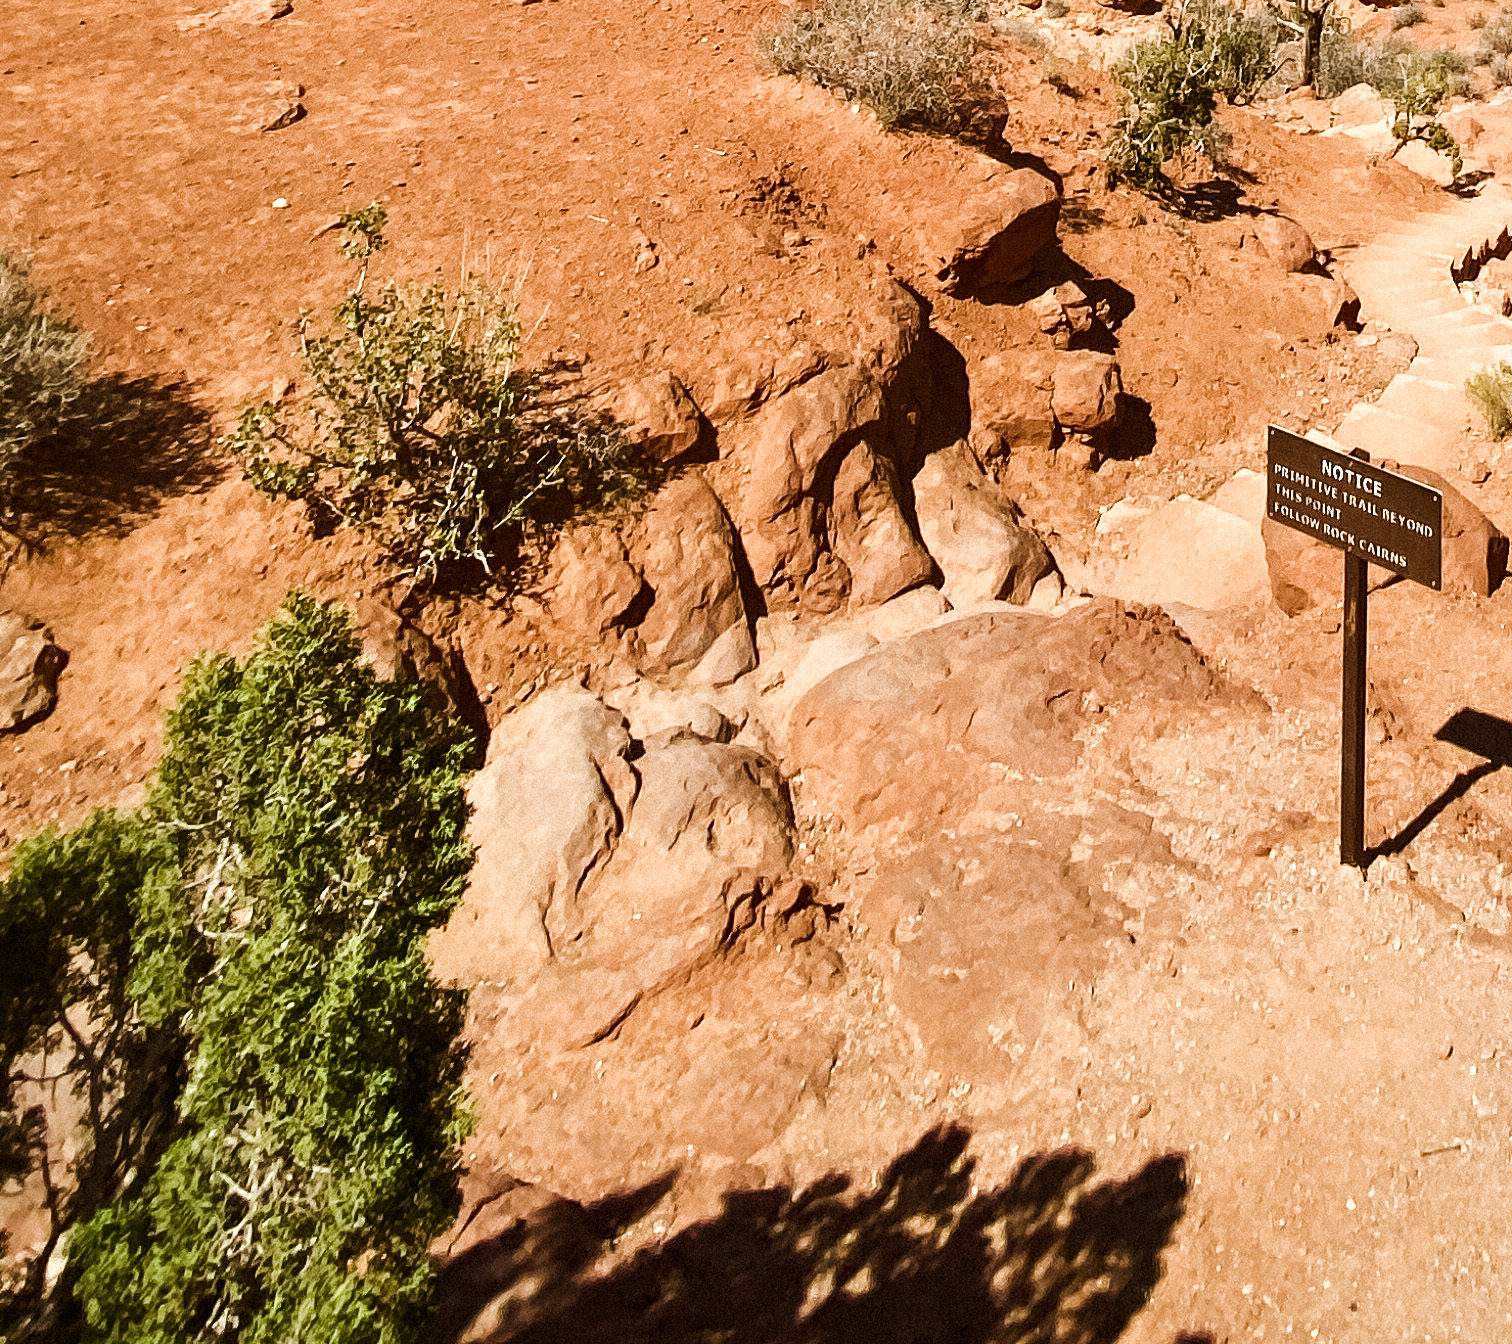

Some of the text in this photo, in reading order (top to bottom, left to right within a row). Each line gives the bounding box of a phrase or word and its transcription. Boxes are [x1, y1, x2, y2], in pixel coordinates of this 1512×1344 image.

[1274, 463, 1433, 538] PRIMITIVE TRAIL BEYOND
[1276, 483, 1342, 520] THIS POINT
[1322, 459, 1382, 498] NOTICE
[1274, 502, 1407, 568] FOLLOW ROCK CAIRNS
